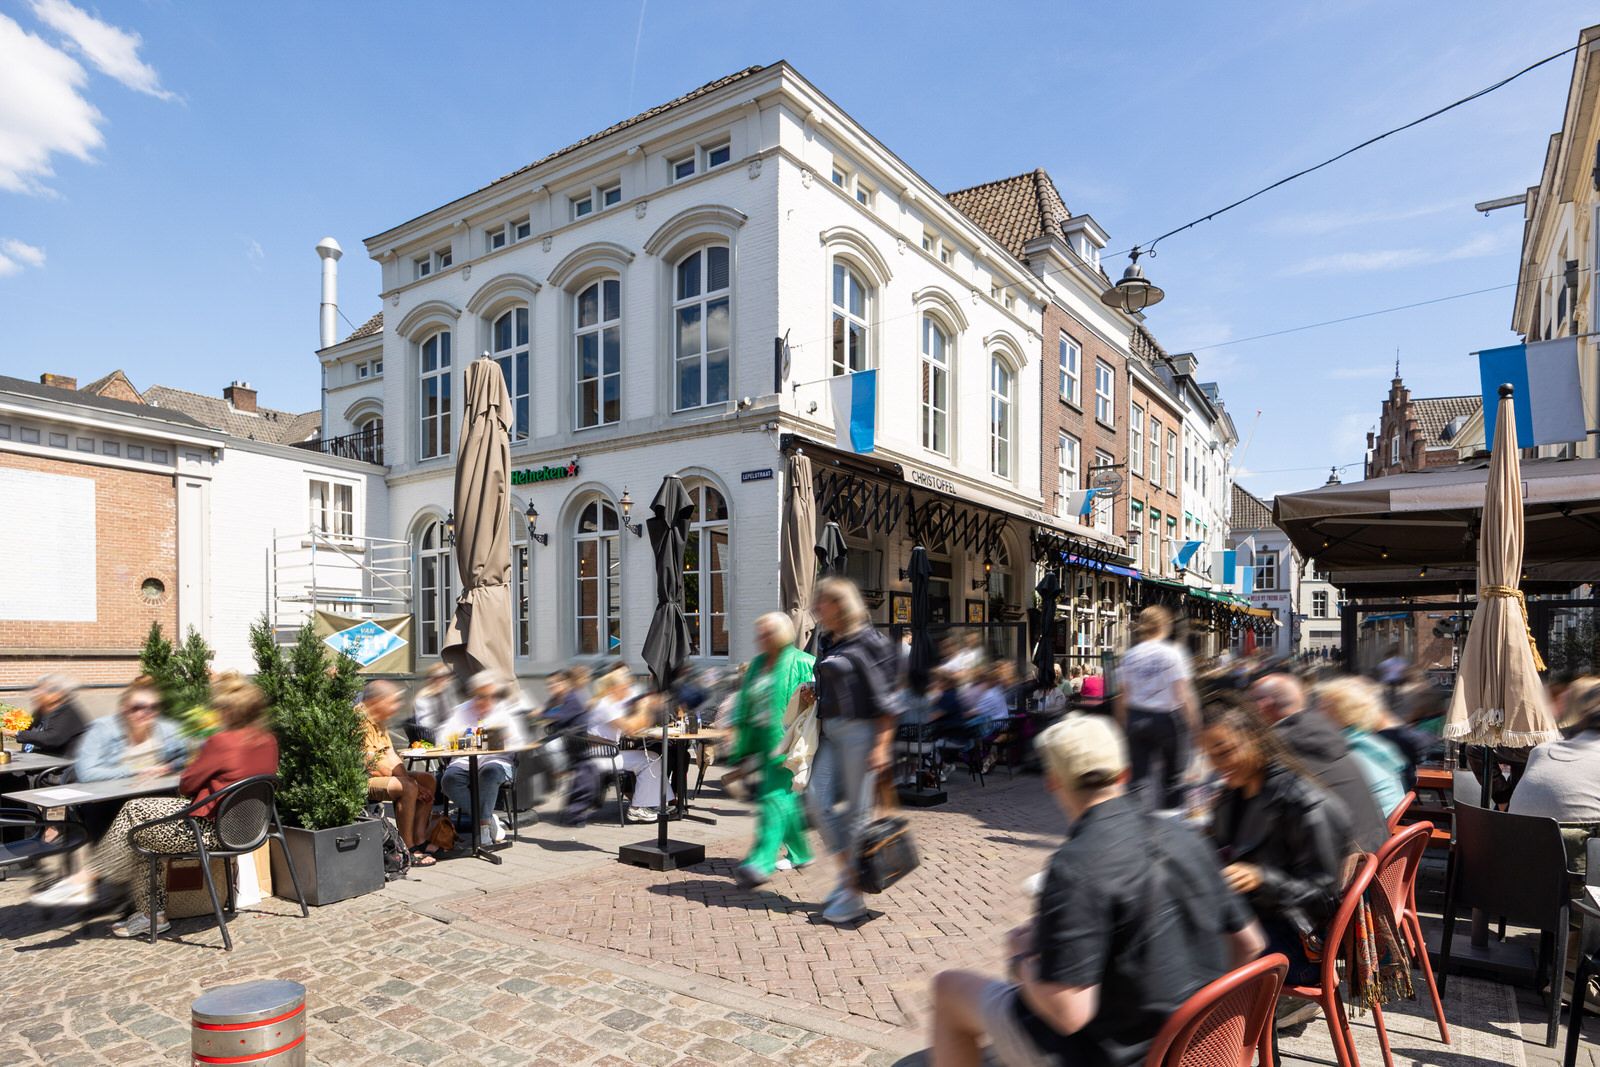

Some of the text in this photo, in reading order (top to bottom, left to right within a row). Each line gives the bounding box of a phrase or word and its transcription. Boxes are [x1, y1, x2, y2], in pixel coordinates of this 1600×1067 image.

[511, 466, 567, 485] Heineken
[742, 471, 771, 480] LEPELSTRAAT
[911, 470, 957, 495] CHRISTOFFEL
